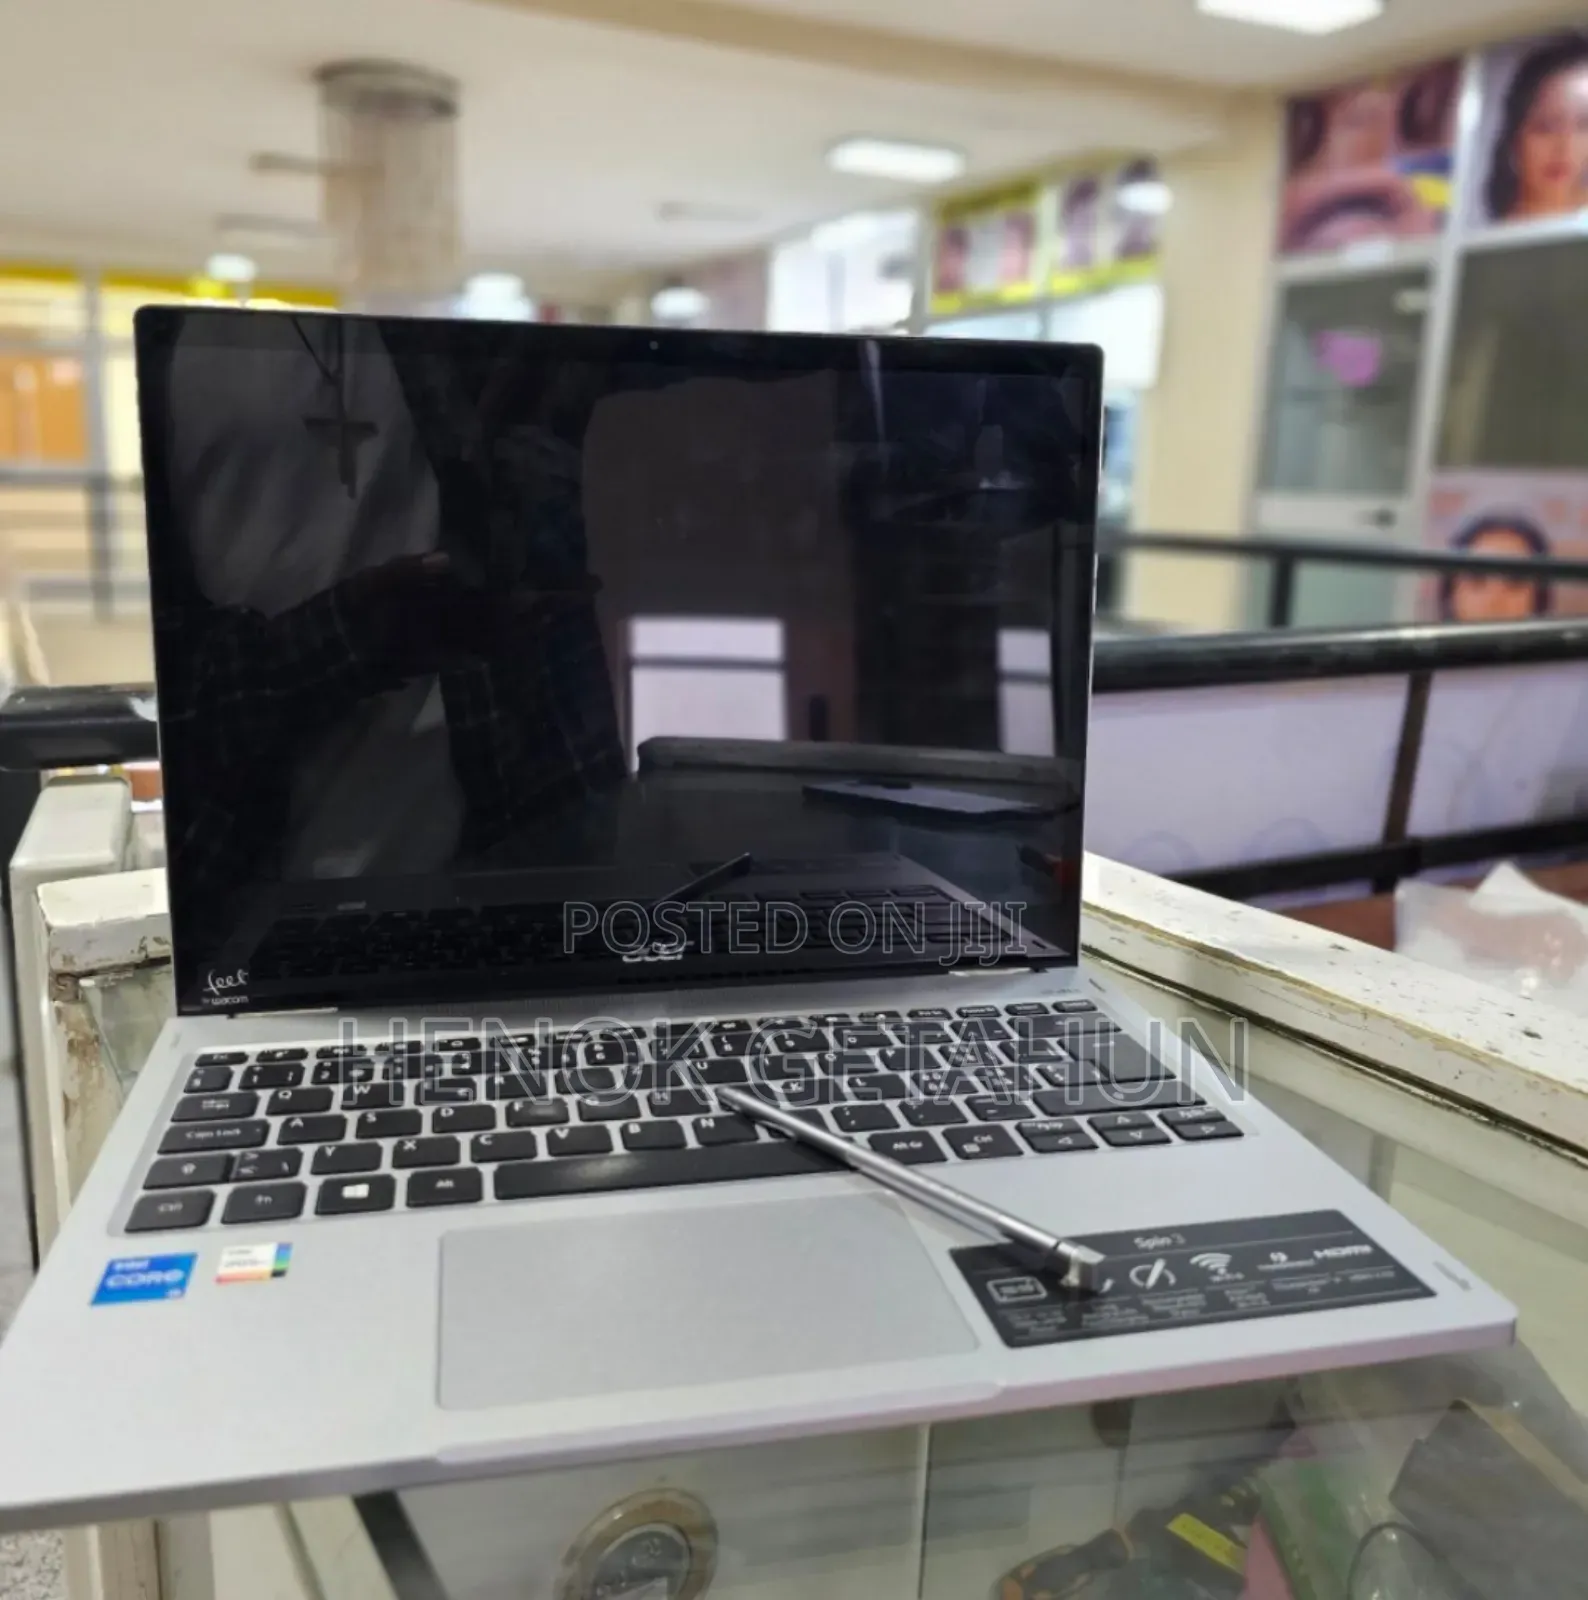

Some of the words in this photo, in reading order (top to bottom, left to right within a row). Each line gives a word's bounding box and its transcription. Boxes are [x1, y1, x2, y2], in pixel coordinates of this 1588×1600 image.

[696, 1061, 709, 1071] U
[855, 1077, 867, 1087] L
[278, 1089, 293, 1100] Q
[353, 1085, 371, 1095] W
[365, 1111, 378, 1123] S
[440, 1107, 455, 1118] D
[289, 1117, 304, 1129] A
[627, 1122, 642, 1135] B
[700, 1117, 716, 1129] N
[554, 1127, 570, 1139] V
[973, 1132, 993, 1144] Ctrl
[402, 1138, 418, 1151] X
[478, 1134, 494, 1146] C
[324, 1145, 337, 1158] Y
[1133, 1234, 1172, 1251] Spin
